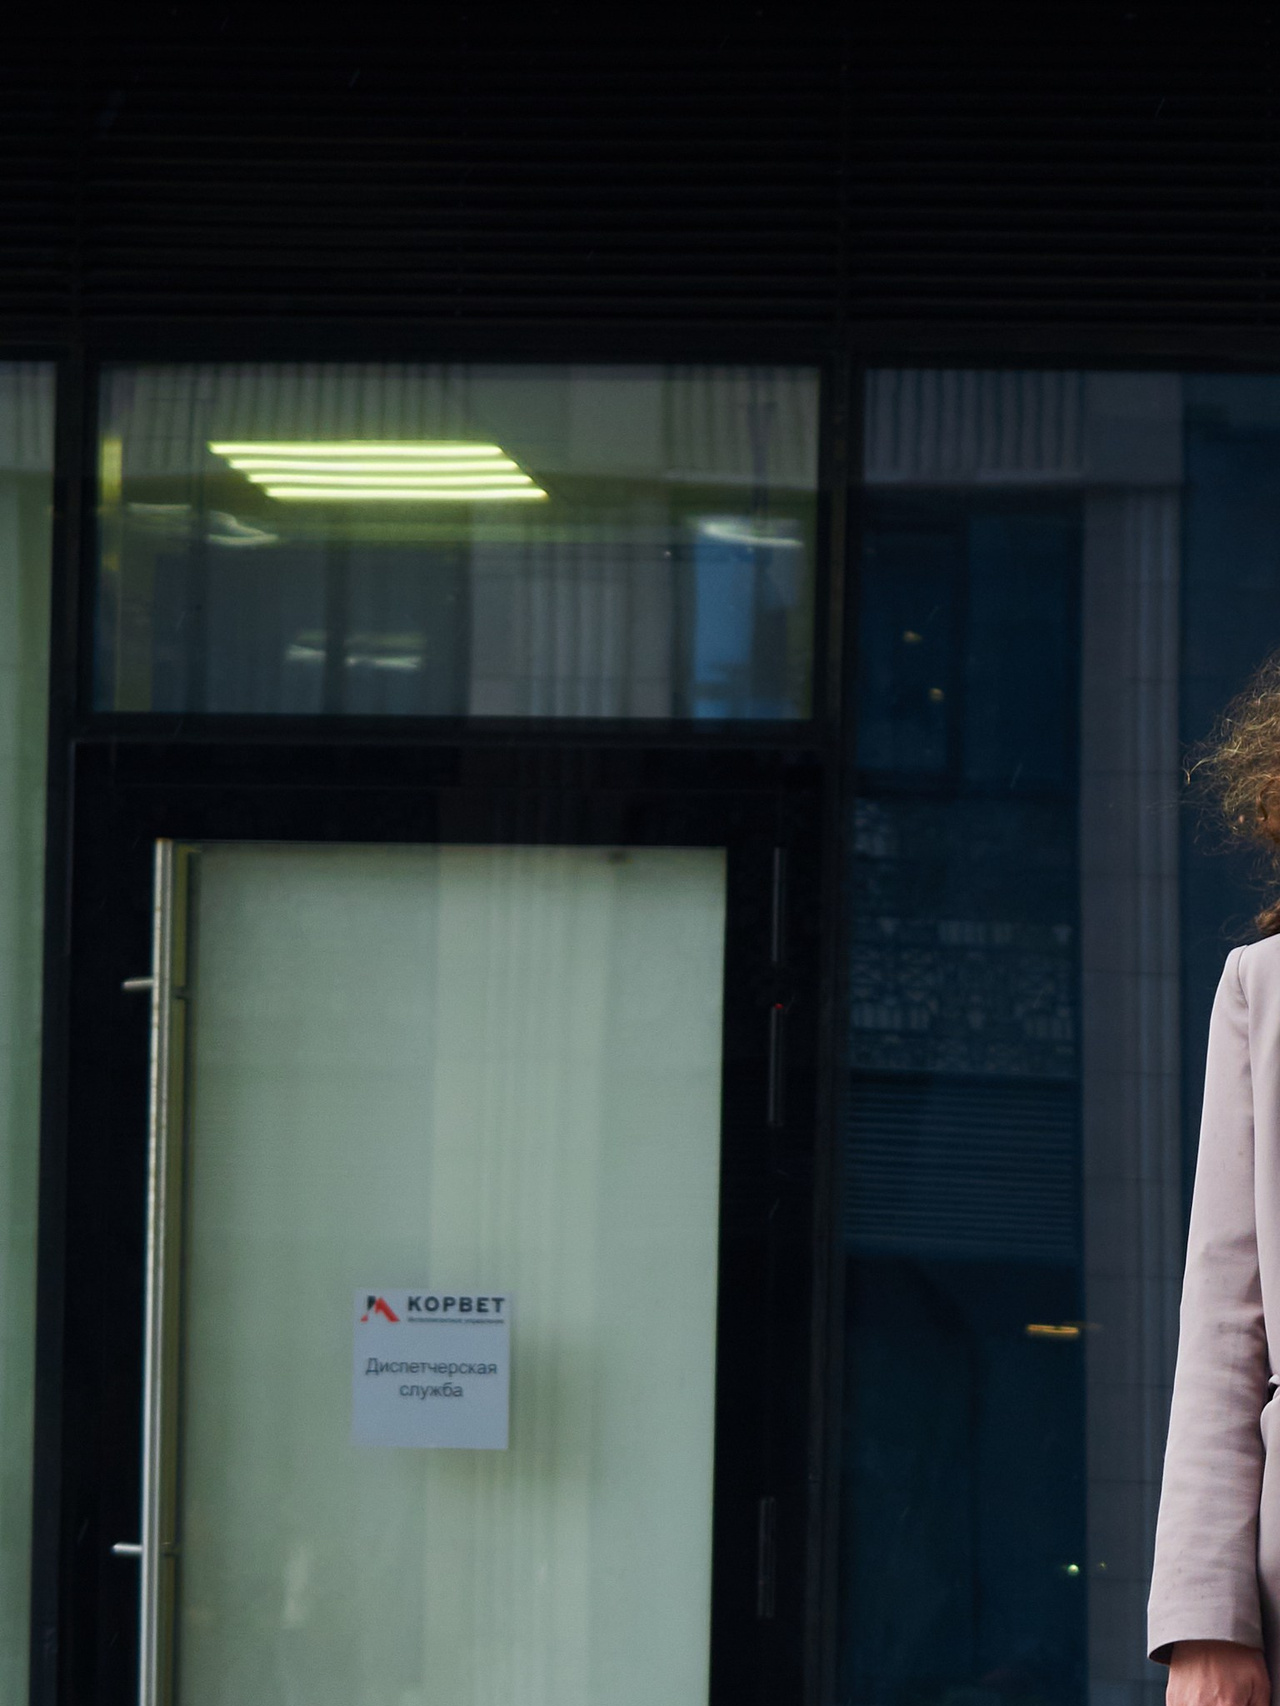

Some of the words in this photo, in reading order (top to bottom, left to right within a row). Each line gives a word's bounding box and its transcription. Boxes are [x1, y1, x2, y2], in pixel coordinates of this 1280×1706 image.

[407, 1296, 505, 1313] КОРВЕТ
[365, 1357, 498, 1377] Диспетчерская
[400, 1382, 464, 1400] служба
